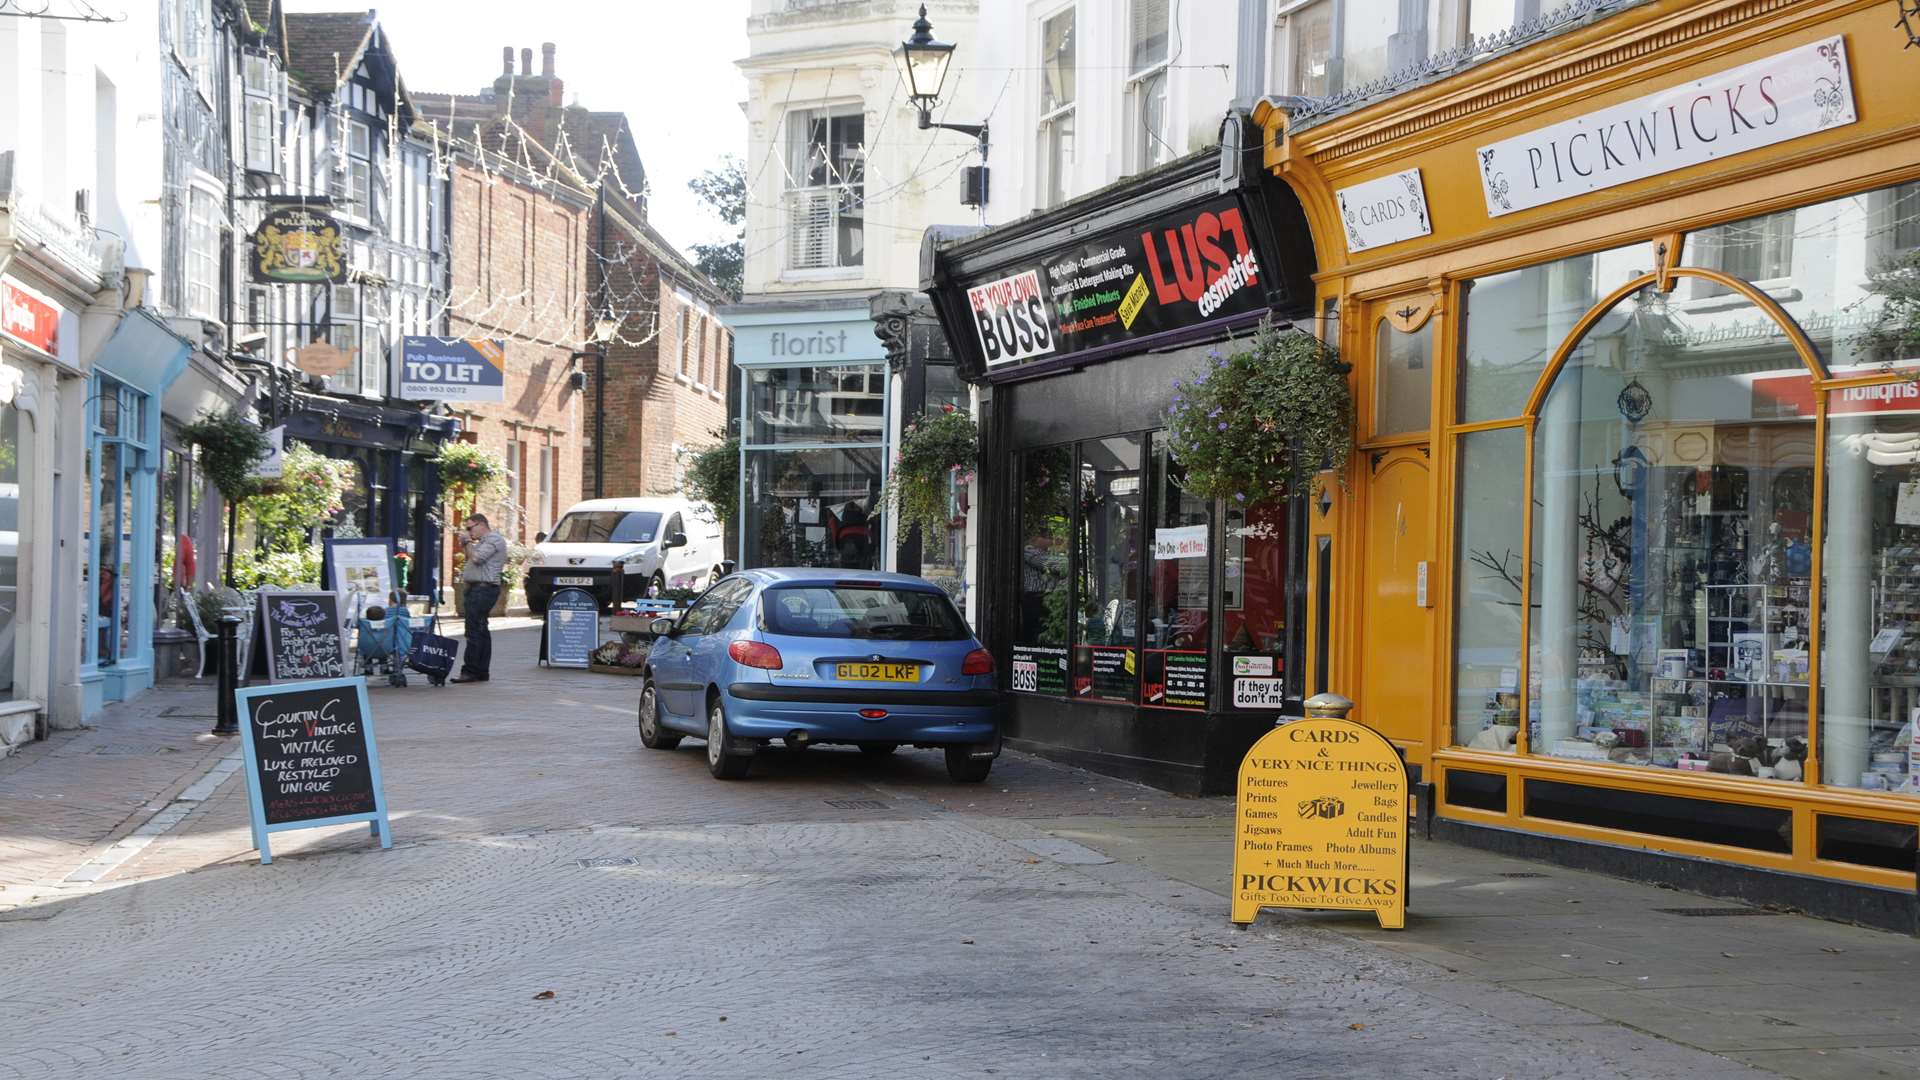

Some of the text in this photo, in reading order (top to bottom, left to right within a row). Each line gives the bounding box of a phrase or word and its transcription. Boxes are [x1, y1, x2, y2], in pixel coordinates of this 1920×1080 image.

[1527, 75, 1780, 190] PICKWICKS
[289, 211, 310, 220] THE
[1360, 196, 1405, 227] CARDS
[1049, 265, 1061, 279] High
[1060, 261, 1079, 275] Quality
[1080, 250, 1110, 269] Commercial
[1109, 245, 1126, 260] Grade
[1141, 207, 1258, 305] LUST
[1051, 264, 1134, 297] Cosmetics & Detergent Making Kits
[971, 273, 1039, 311] BE YOUR OWN
[1073, 294, 1096, 311] Finished
[1095, 289, 1120, 305] Products
[976, 295, 1049, 360] BOSS
[770, 329, 847, 356] florist
[406, 353, 467, 362] Pub Business
[406, 362, 483, 383] TO LET
[1167, 542, 1176, 554] One
[837, 664, 915, 680] GL02 LKF
[1013, 669, 1036, 690] BOSS
[1238, 680, 1245, 692] If
[1249, 680, 1270, 695] they
[1238, 692, 1265, 703] don't
[263, 720, 357, 739] LILY VINTAGE
[1289, 729, 1360, 743] CARDS
[281, 739, 335, 754] VINTAGE
[1317, 747, 1329, 758] &
[264, 754, 358, 771] LUXE PRELOVED
[1250, 758, 1397, 773] VERY NICE THINGS
[278, 767, 340, 782] RESTYLED
[1247, 776, 1288, 788] Pictures
[280, 781, 332, 794] UNIQUE
[1351, 780, 1398, 792] Jewellery
[1246, 793, 1277, 803] Prints
[1374, 797, 1398, 809] Bags
[1245, 809, 1278, 819] Games
[1357, 812, 1397, 823] Candles
[1244, 825, 1282, 836] Jigsaws
[1346, 827, 1397, 839] Adult Fun
[1244, 841, 1313, 852] Photo Frames
[1326, 843, 1397, 855] Photo Albums
[1276, 859, 1302, 870] Much
[1305, 860, 1331, 871] Much
[1241, 874, 1397, 896] PICKWICKS
[1240, 892, 1395, 908] Gifts Too Nice To Give Away
